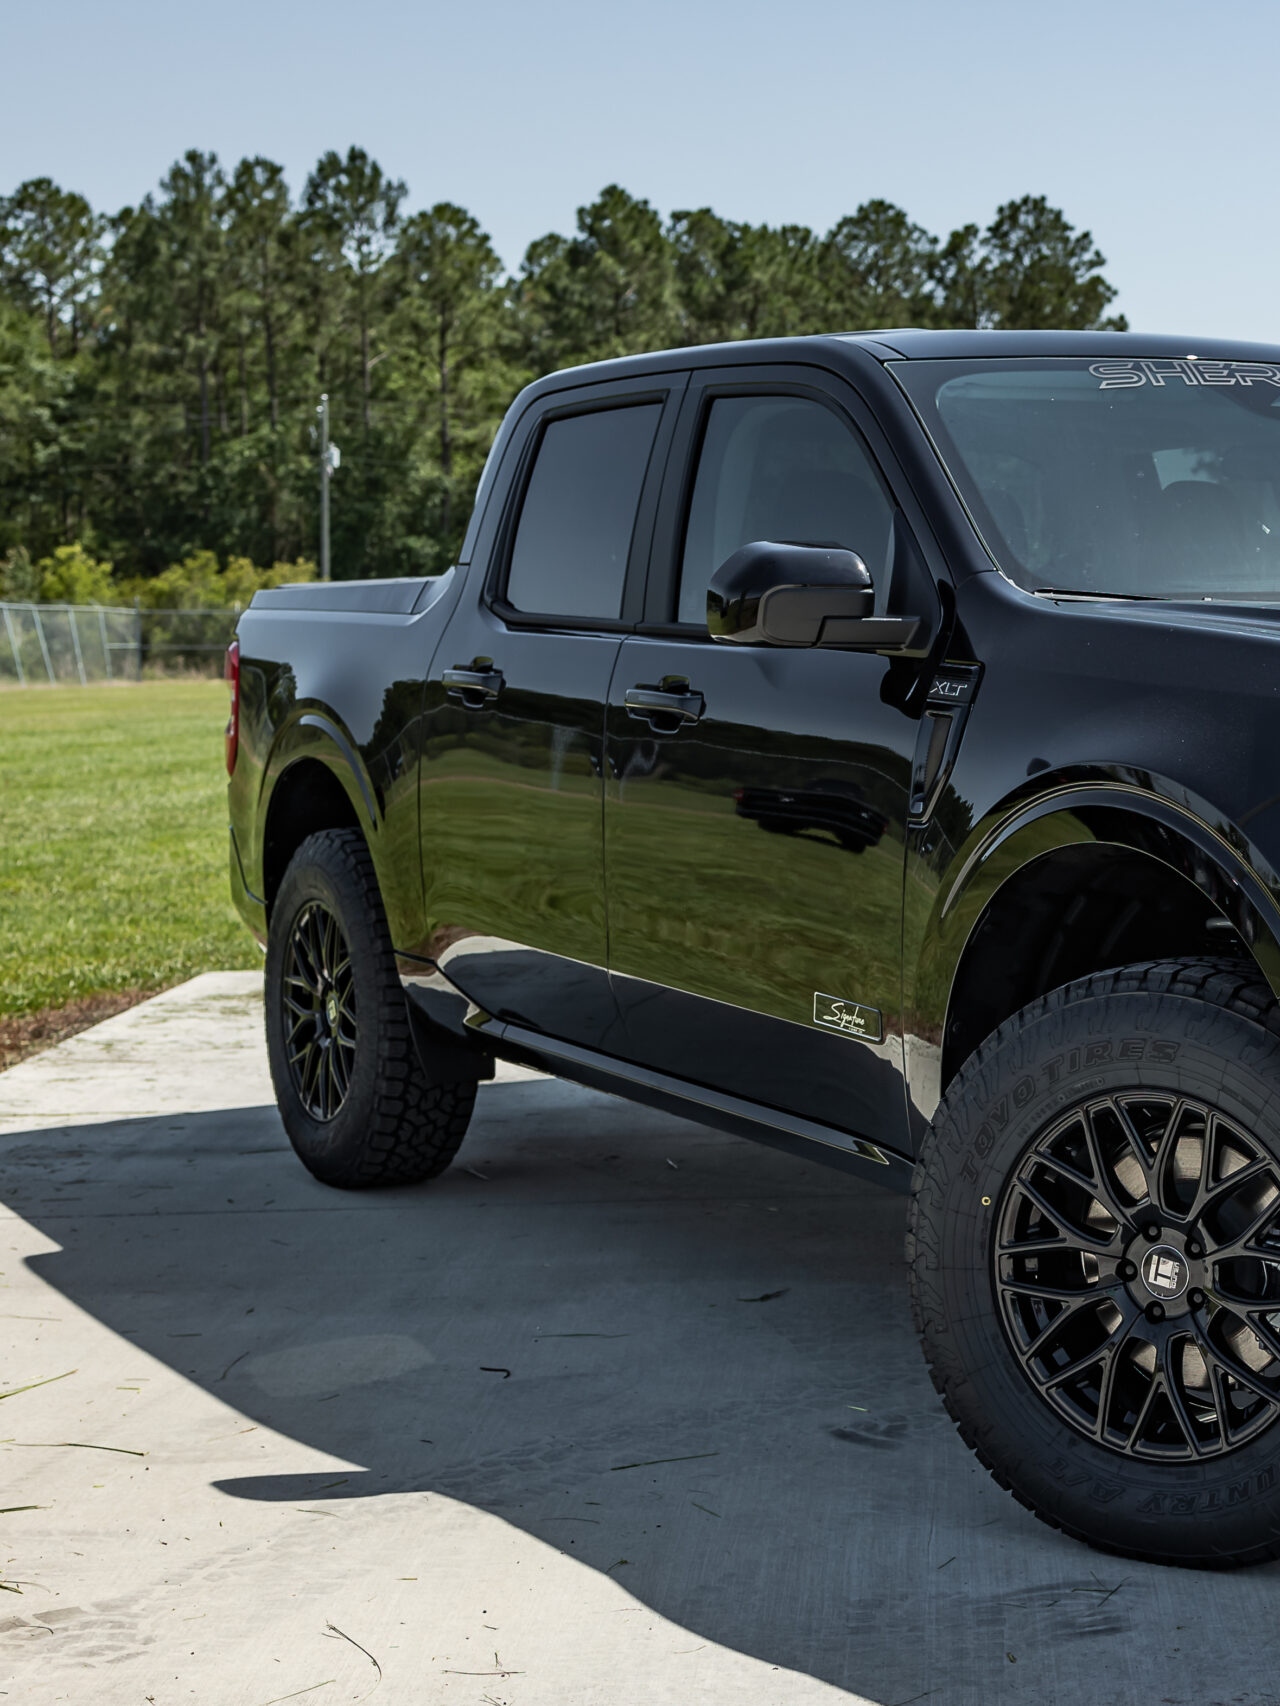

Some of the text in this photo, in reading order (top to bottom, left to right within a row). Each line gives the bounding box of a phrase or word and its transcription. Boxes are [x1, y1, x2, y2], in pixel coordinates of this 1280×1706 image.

[929, 681, 968, 696] XLT
[960, 1075, 1038, 1184] TOYO
[1040, 1038, 1181, 1085] TIRES
